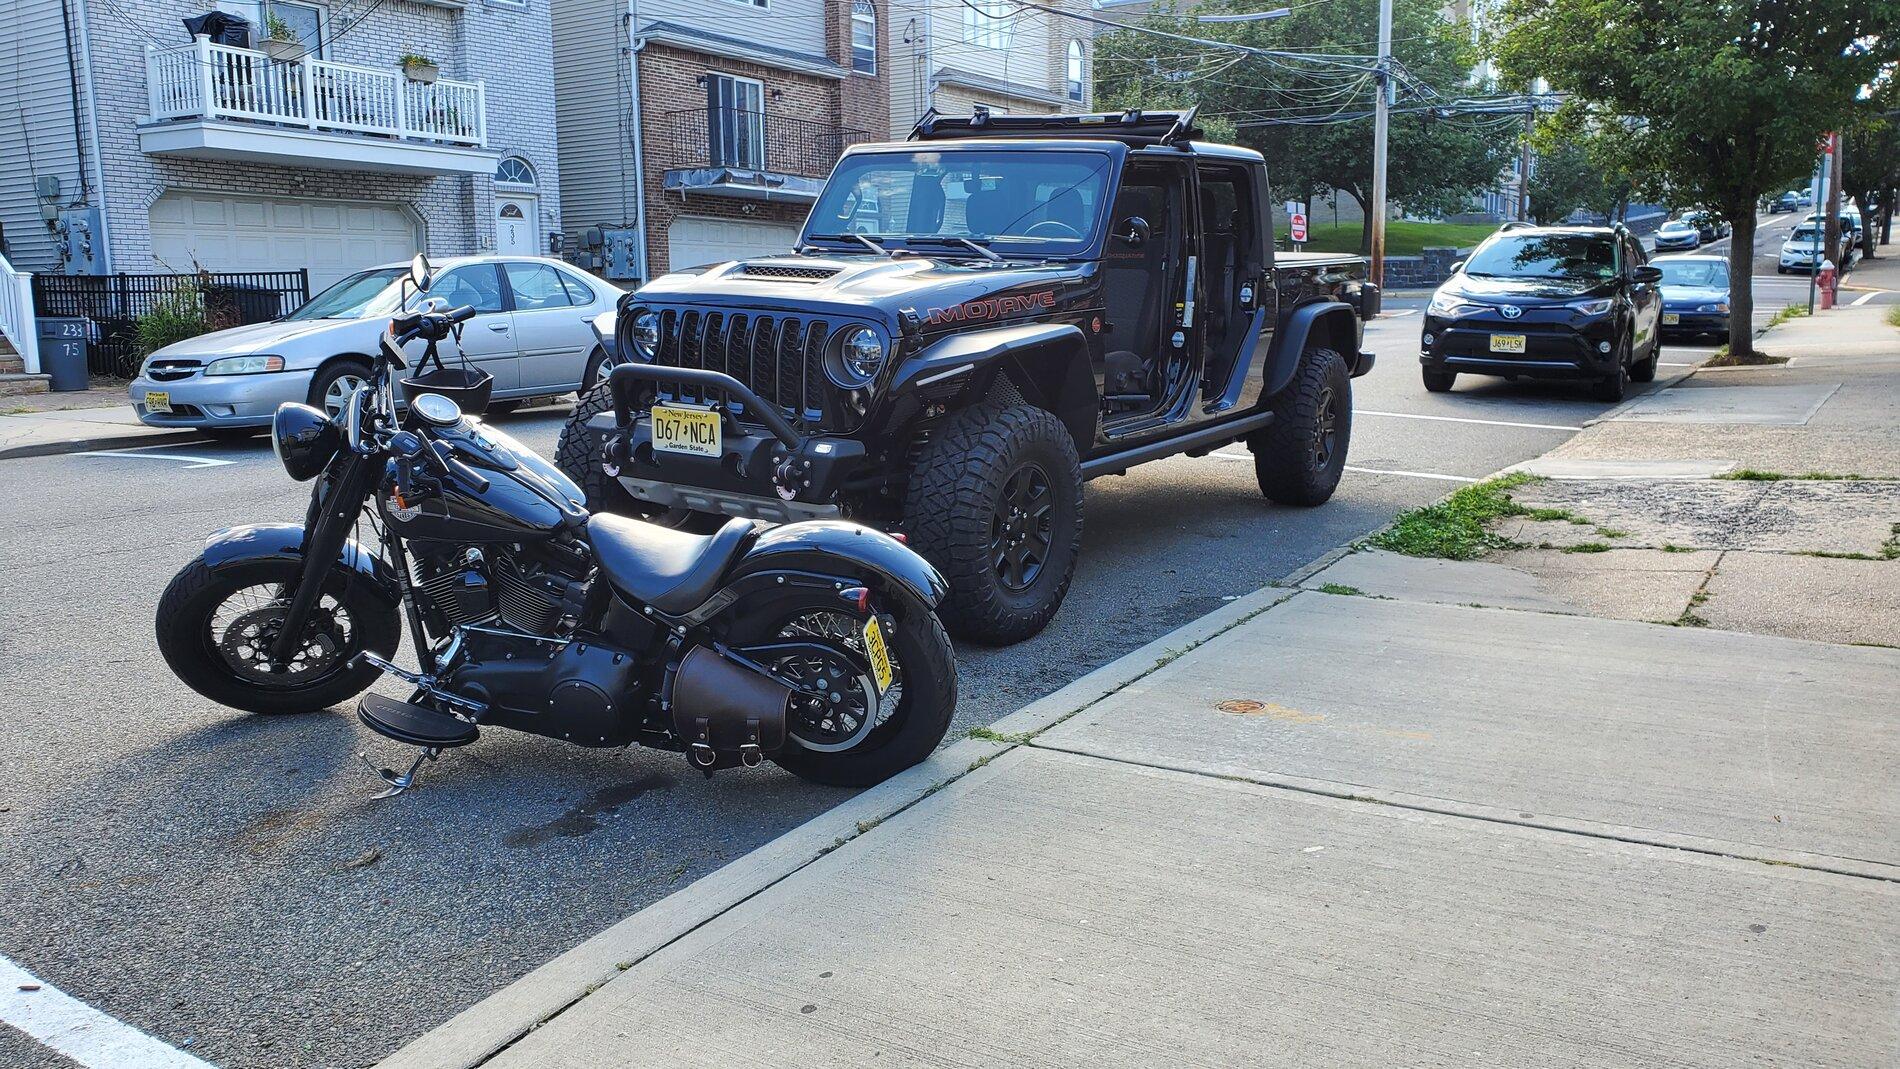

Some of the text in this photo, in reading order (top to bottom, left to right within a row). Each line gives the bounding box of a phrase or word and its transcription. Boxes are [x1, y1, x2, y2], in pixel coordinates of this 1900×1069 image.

[927, 290, 1056, 324] MOJAVE
[63, 323, 83, 337] 233
[63, 342, 80, 356] 75
[668, 409, 704, 421] New Jersey
[668, 442, 688, 451] Garden
